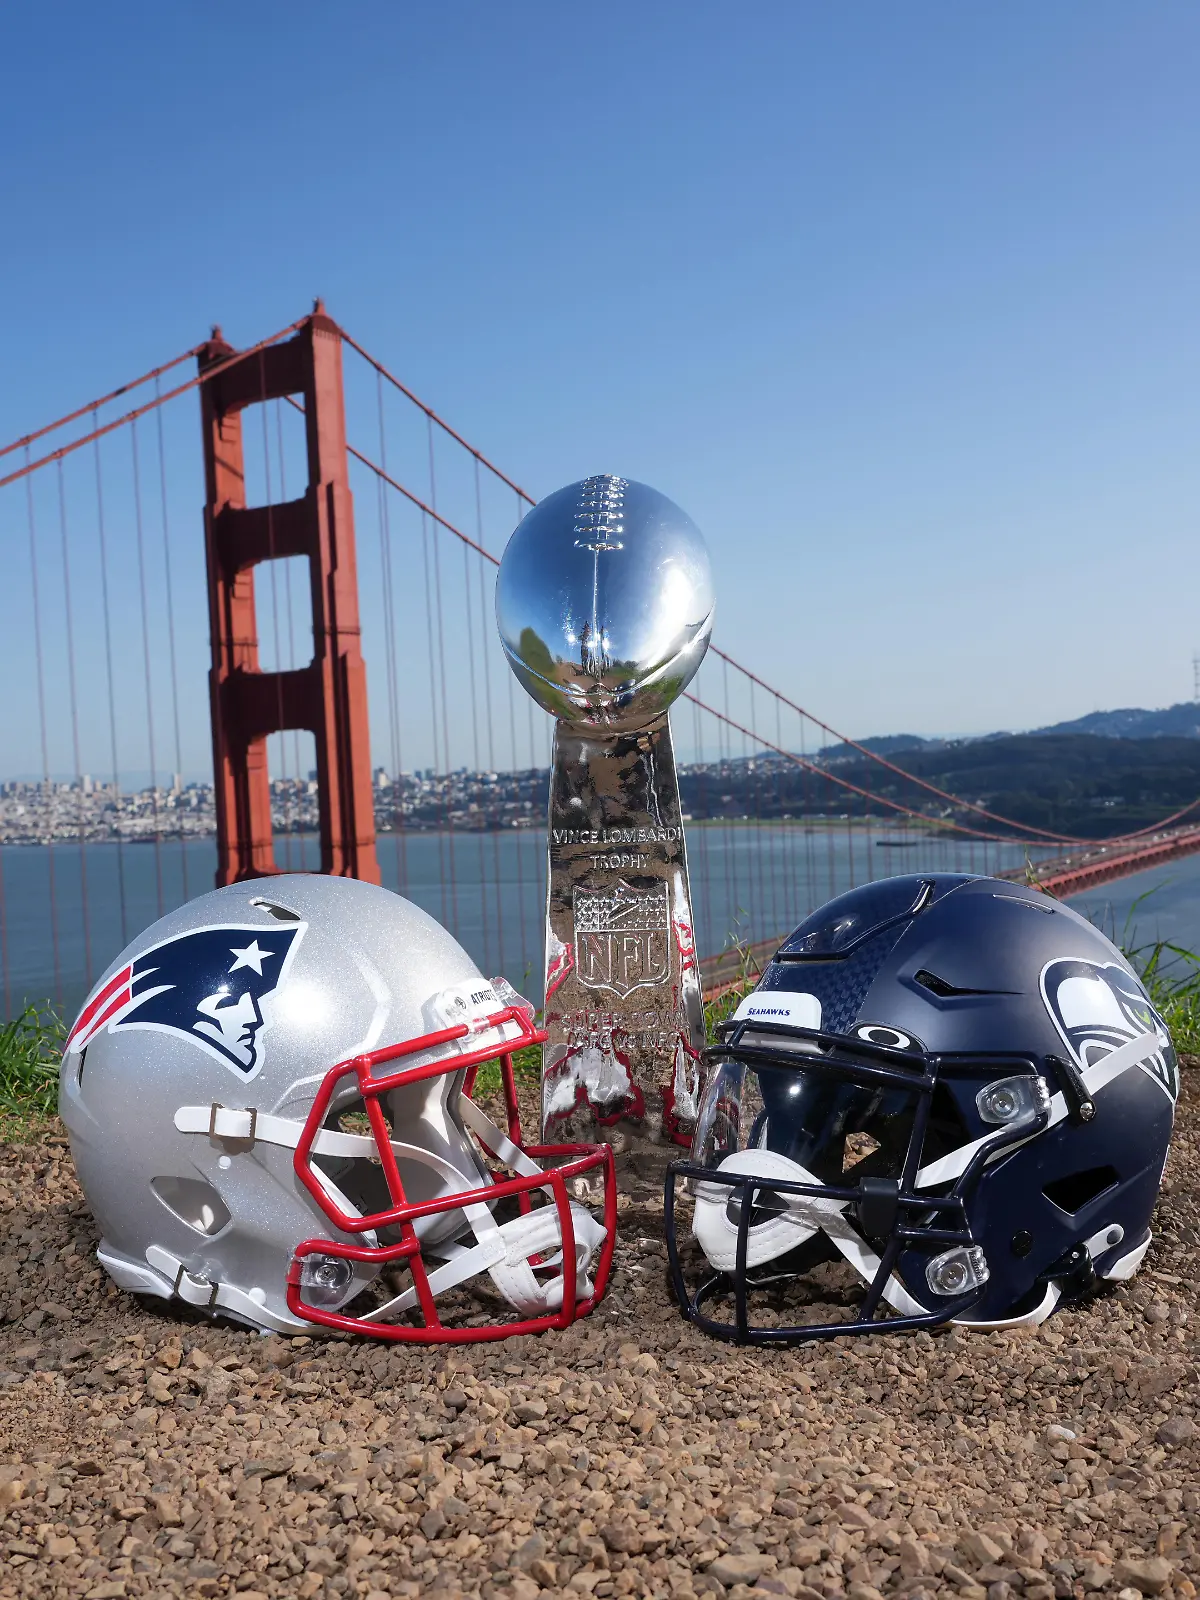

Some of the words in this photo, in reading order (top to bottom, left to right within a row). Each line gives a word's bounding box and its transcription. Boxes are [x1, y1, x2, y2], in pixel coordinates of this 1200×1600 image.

[552, 828, 598, 844] VINCE
[602, 826, 681, 844] LOMBARDI
[590, 853, 650, 869] TROPHY
[582, 932, 666, 989] NFL
[747, 1007, 791, 1017] SEAHAWKS
[561, 1010, 623, 1033] SUPER
